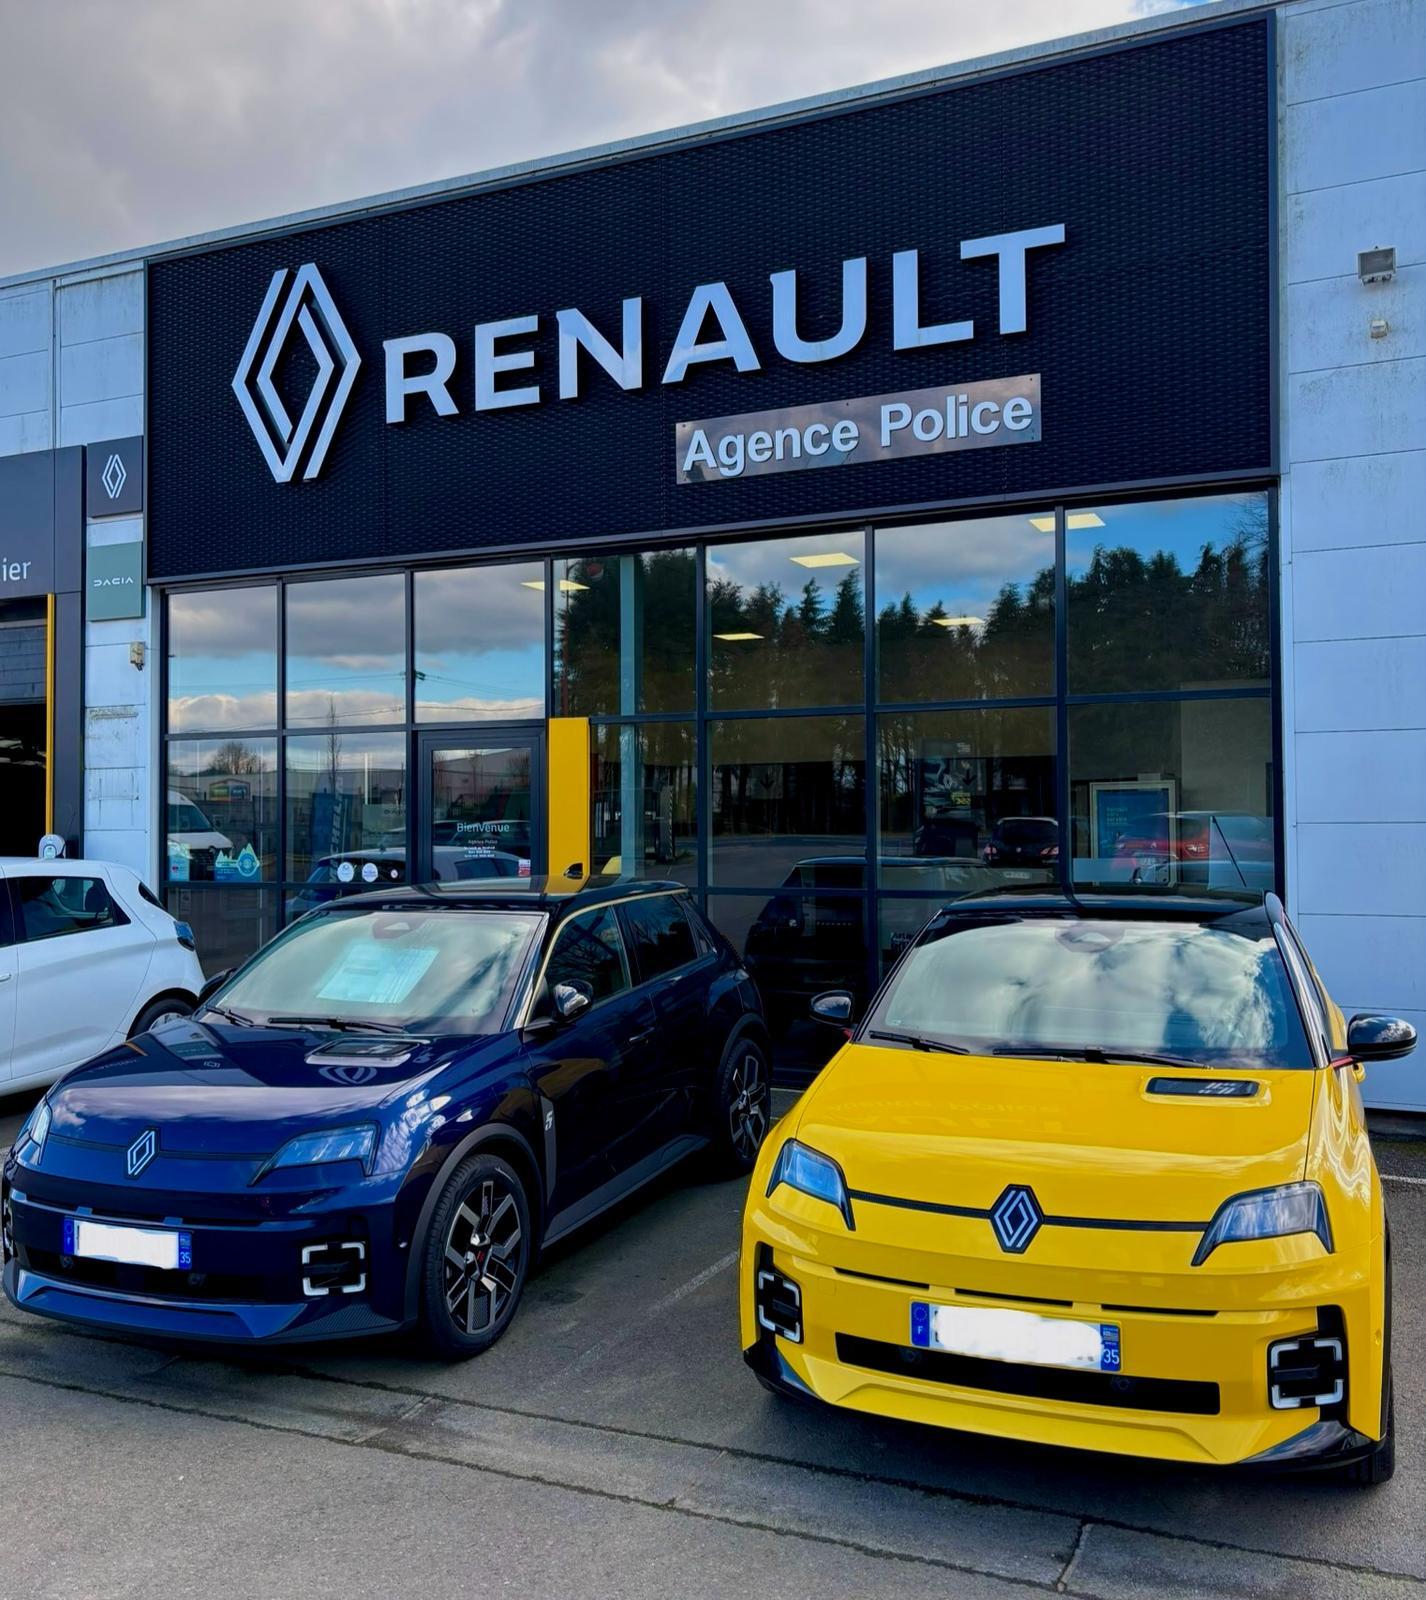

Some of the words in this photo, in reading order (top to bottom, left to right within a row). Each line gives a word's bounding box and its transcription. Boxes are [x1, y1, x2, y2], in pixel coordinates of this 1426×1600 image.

[383, 223, 1065, 424] RENAULT
[682, 419, 858, 477] Agence
[880, 395, 1032, 447] Police
[93, 577, 134, 587] DACIA
[456, 822, 510, 833] Bienvenue
[180, 1252, 191, 1264] 35
[1103, 1348, 1119, 1364] 35
